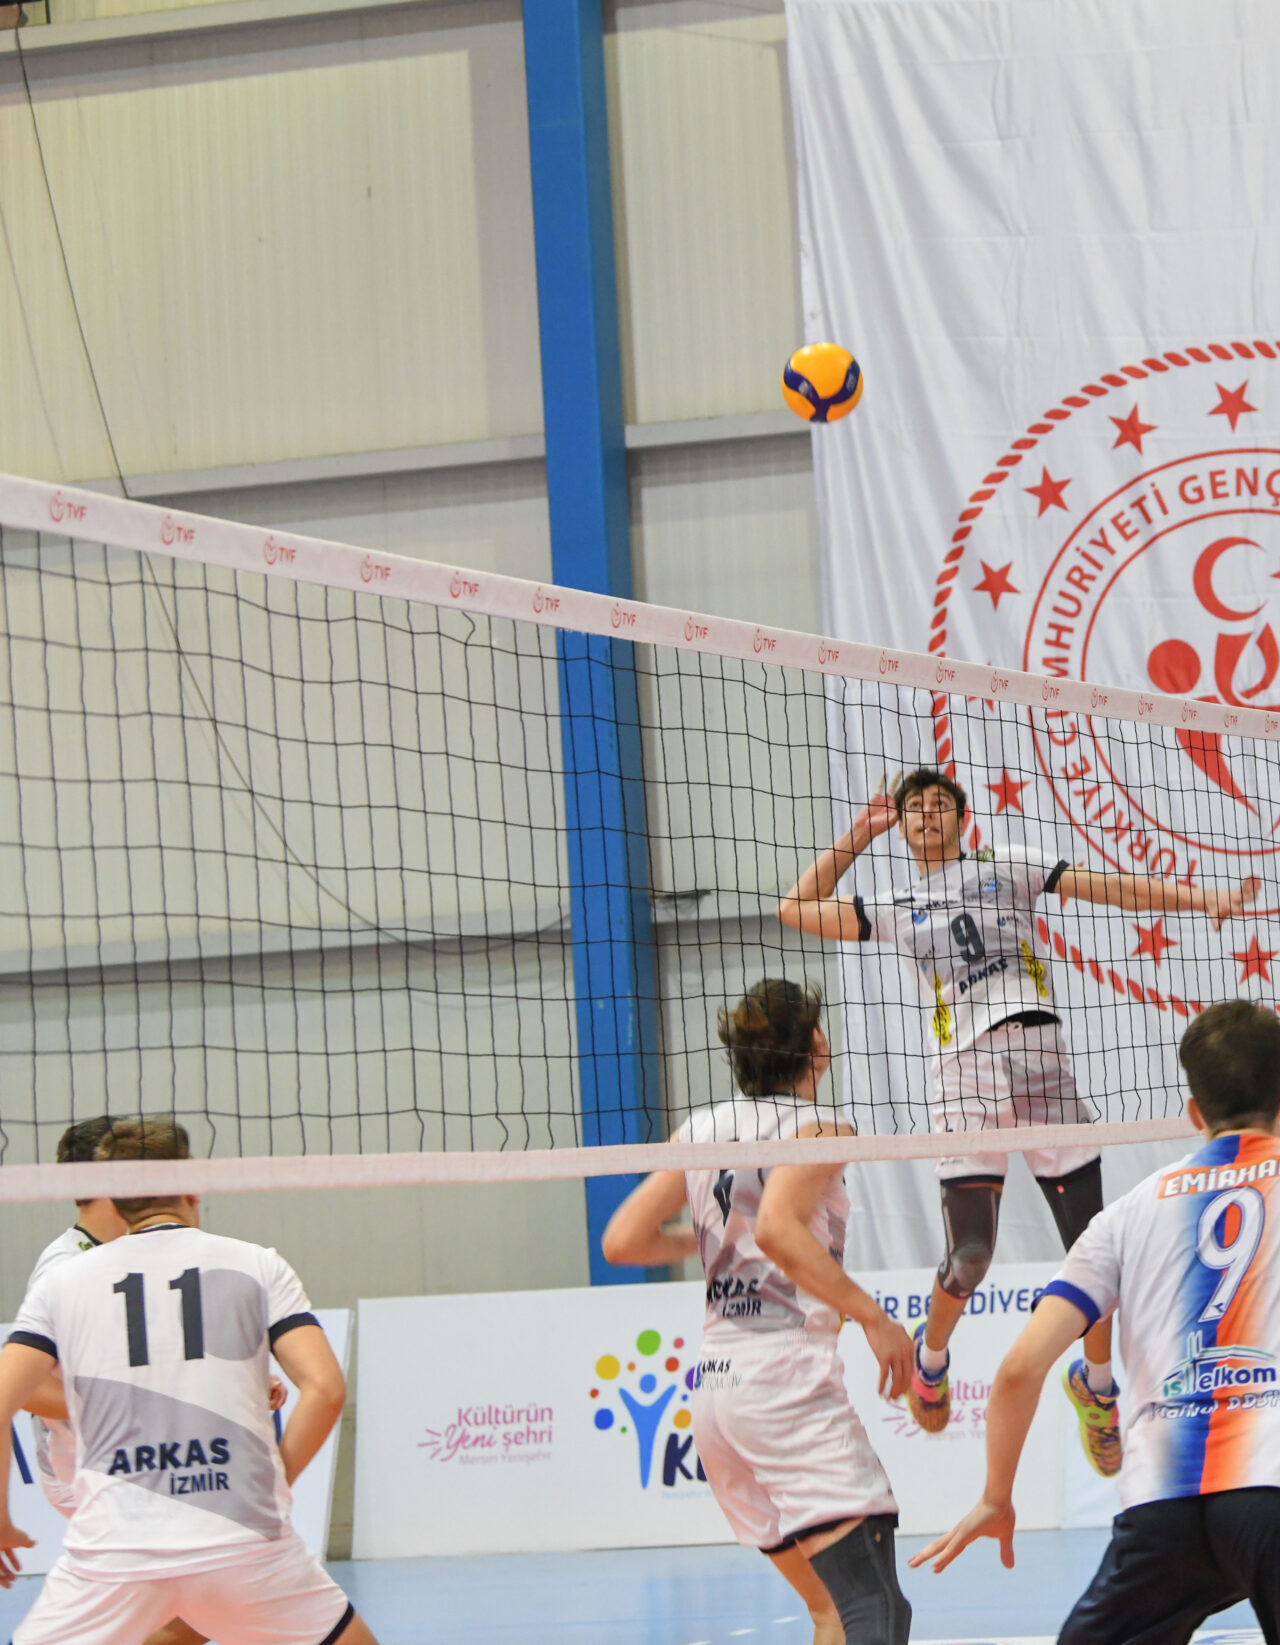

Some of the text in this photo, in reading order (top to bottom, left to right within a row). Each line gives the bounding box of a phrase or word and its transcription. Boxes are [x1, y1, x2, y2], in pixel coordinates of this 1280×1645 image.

[67, 503, 87, 521] TVF
[176, 526, 196, 543] TVF
[279, 546, 297, 563] TVF
[374, 565, 391, 581] TVF
[462, 581, 480, 595] TVF
[545, 597, 560, 612] TVF
[621, 612, 637, 627] TVF
[694, 625, 708, 639] TVF
[763, 637, 776, 651] TVF
[827, 649, 840, 663] TVF
[887, 660, 899, 672] TVF
[951, 913, 986, 965] 9
[1196, 1185, 1266, 1323] 9
[112, 1267, 205, 1367] 11
[457, 1402, 553, 1427] Kültürün
[107, 1437, 231, 1477] ARKAS
[440, 1423, 553, 1463] Yeni şehri
[169, 1470, 230, 1496] İZMİR
